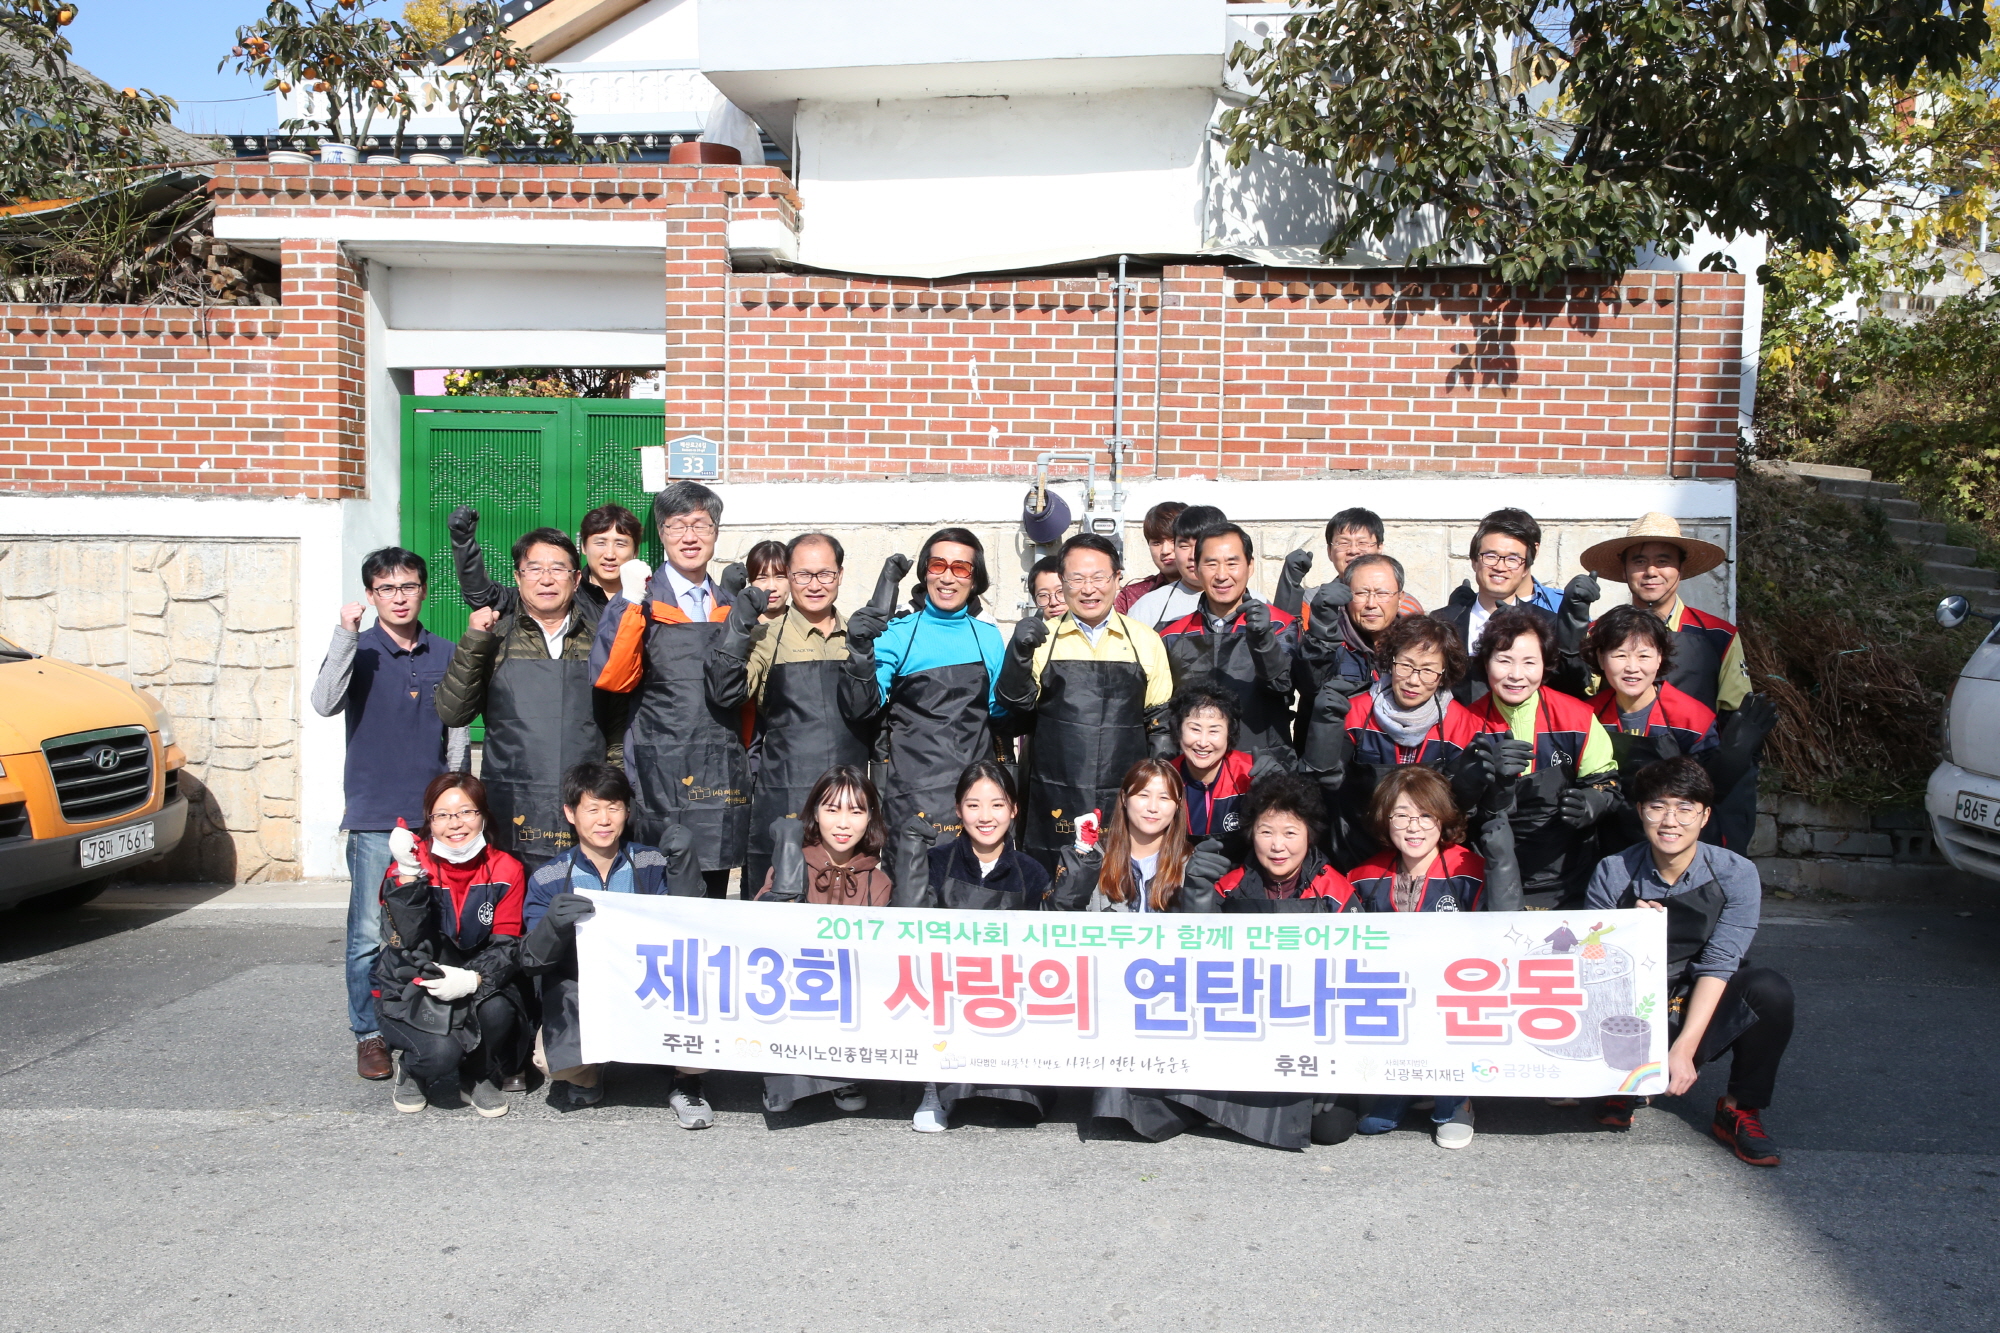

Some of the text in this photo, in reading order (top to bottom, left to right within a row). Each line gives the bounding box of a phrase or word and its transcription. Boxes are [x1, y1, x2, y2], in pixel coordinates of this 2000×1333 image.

[682, 456, 704, 474] 33
[1963, 798, 1988, 822] 86두
[89, 829, 148, 861] 78마 7661
[817, 917, 1390, 951] 2017 지역사회 시민모두가 함께 만들어가는
[635, 938, 1583, 1041] 제13회 사랑의 연탄나눔 운동
[662, 1033, 704, 1055] 주관
[769, 1042, 919, 1066] 익산시노인종합복지관
[1274, 1054, 1319, 1078] 후원
[1384, 1068, 1466, 1083] 신광복지재단
[1385, 1059, 1429, 1068] 사회복지법인
[1502, 1063, 1563, 1079] 금강방송
